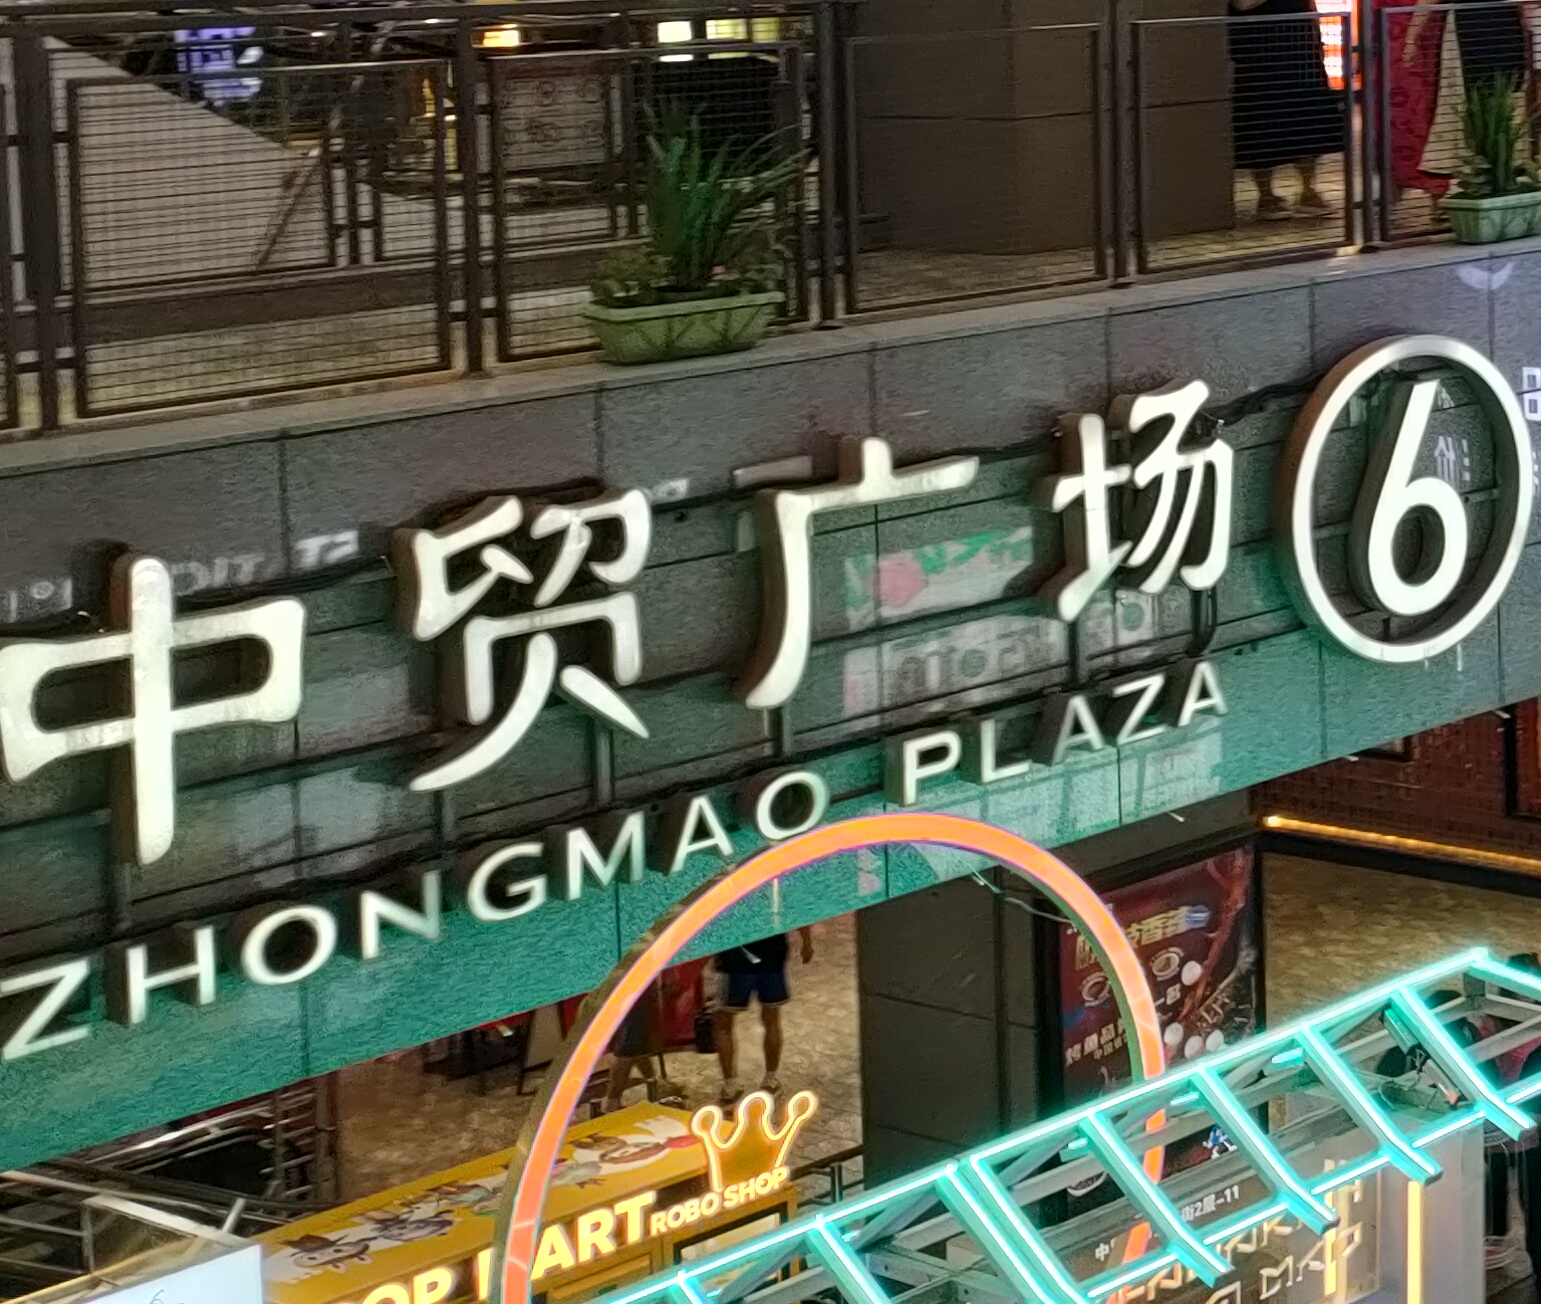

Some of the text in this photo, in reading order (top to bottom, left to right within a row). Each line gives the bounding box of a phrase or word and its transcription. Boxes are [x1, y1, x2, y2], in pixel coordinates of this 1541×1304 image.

[0, 380, 1233, 865] 中贸广场
[0, 661, 1228, 1063] ZHONGMAO PLAZA
[650, 1193, 719, 1236] ROBO
[722, 1166, 789, 1209] SHOP
